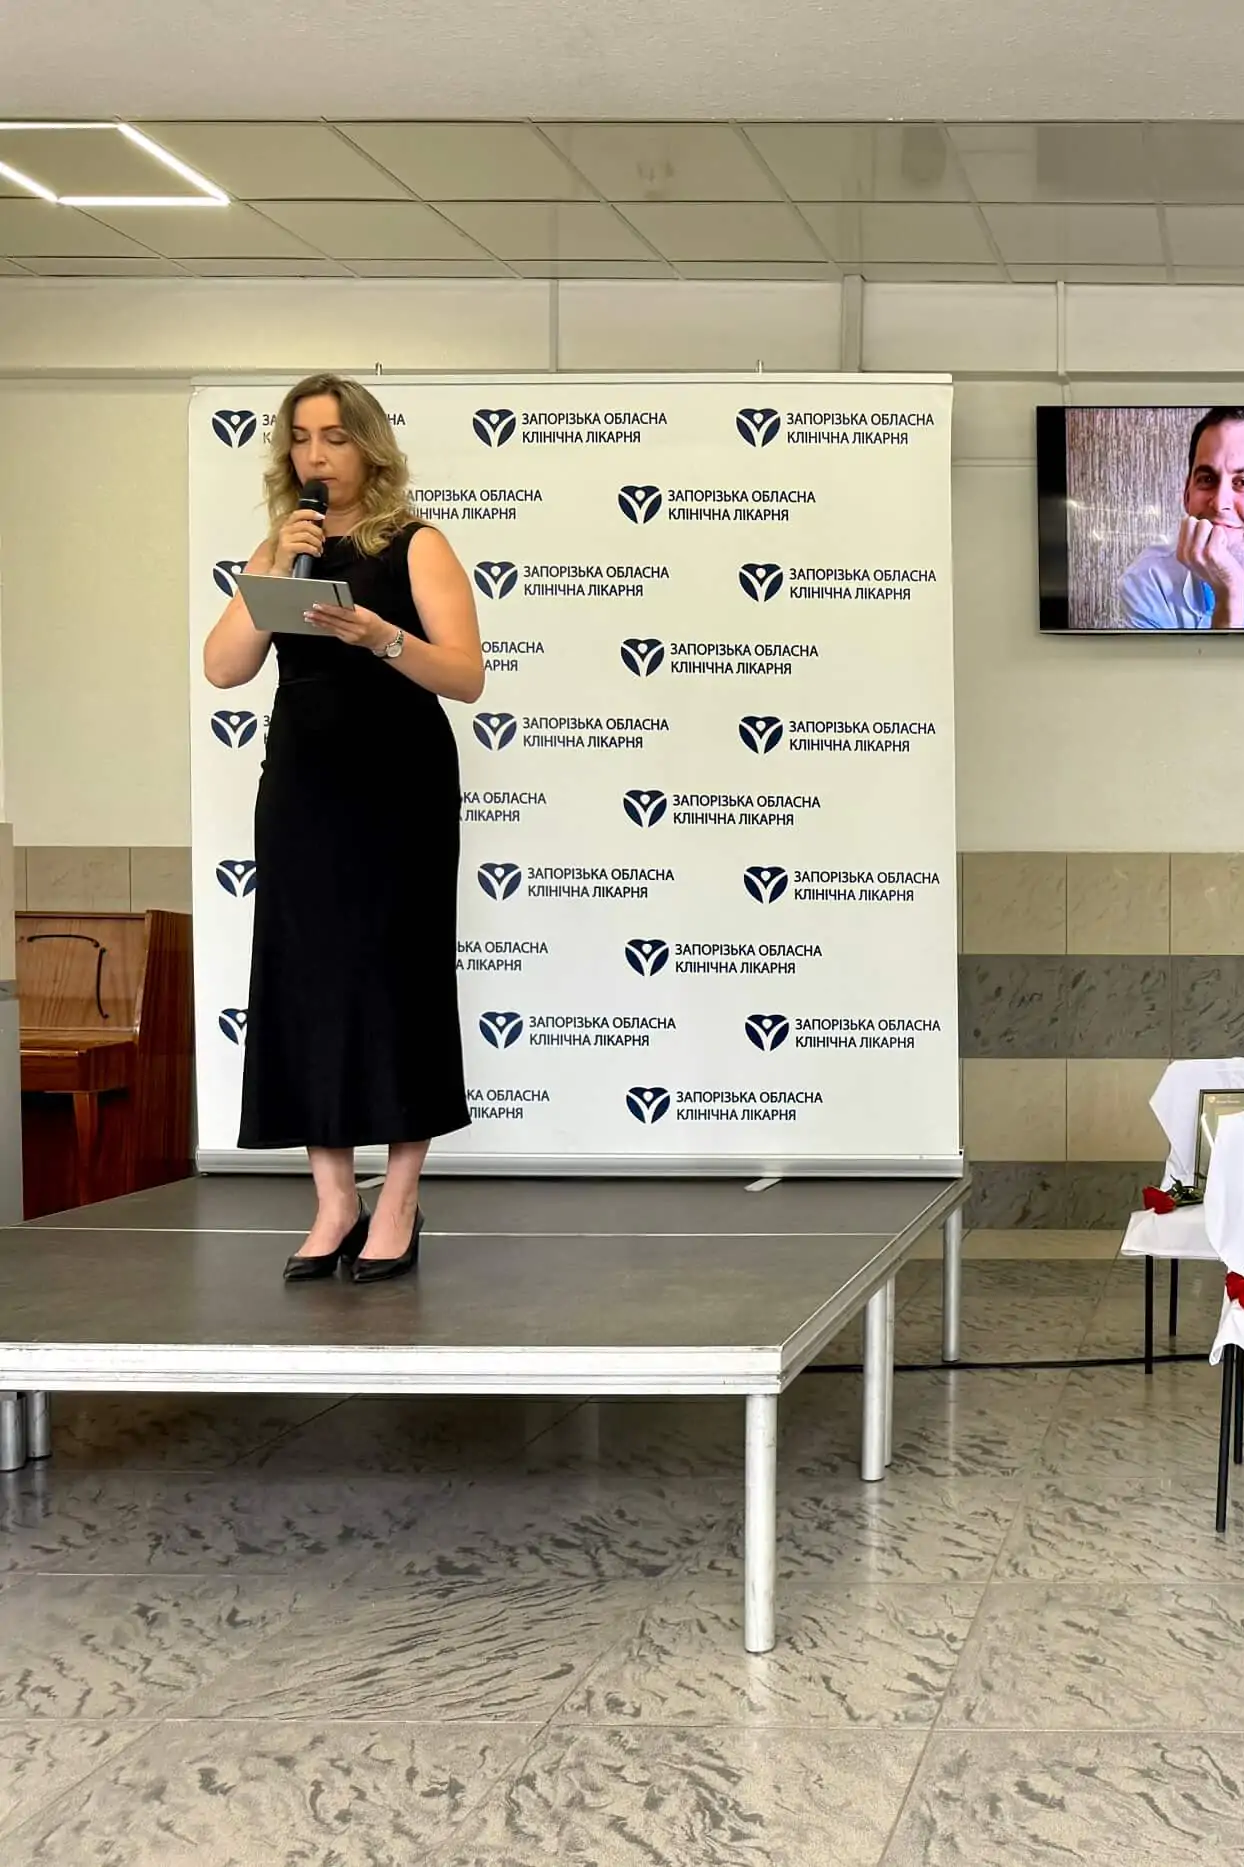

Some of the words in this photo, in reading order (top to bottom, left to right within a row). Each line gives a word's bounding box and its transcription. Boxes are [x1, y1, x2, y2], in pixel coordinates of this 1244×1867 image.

[522, 413, 601, 425] ЗАПОРІЗЬКА
[604, 413, 667, 424] ОБЛАСНА
[787, 413, 867, 425] ЗАПОРІЗЬКА
[871, 413, 934, 426] ОБЛАСНА
[523, 431, 583, 443] КЛІНІЧНА
[586, 431, 640, 443] ЛІКАРНЯ
[788, 432, 849, 444] КЛІНІЧНА
[853, 432, 908, 444] ЛІКАРНЯ
[406, 490, 477, 502] АПОРІЗЬКА
[480, 490, 542, 501] ОБЛАСНА
[668, 490, 748, 502] ЗАПОРІЗЬКА
[752, 490, 815, 503] ОБЛАСНА
[462, 508, 516, 519] ЛІКАРНЯ
[669, 508, 730, 520] КЛІНІЧНА
[734, 509, 788, 521] ЛІКАРНЯ
[524, 566, 603, 578] ЗАПОРІЗЬКА
[606, 566, 669, 578] ОБЛАСНА
[790, 568, 870, 581] ЗАПОРІЗЬКА
[873, 570, 936, 582] ОБЛАСНА
[524, 584, 585, 596] КЛІНІЧНА
[588, 584, 643, 596] ЛІКАРНЯ
[790, 587, 852, 599] КЛІНІЧНА
[855, 588, 910, 600] ЛІКАРНЯ
[481, 641, 545, 653] ОБЛАСНА
[671, 643, 751, 656] ЗАПОРІЗЬКА
[755, 644, 818, 656] ОБЛАСНА
[484, 659, 519, 671] АРНЯ
[671, 661, 733, 674] КЛІНІЧНА
[737, 662, 791, 674] ЛІКАРНЯ
[523, 717, 603, 729] ЗАПОРІЗЬКА
[606, 718, 669, 730] ОБЛАСНА
[789, 721, 870, 733] ЗАПОРІЗЬКА
[873, 722, 935, 734] ОБЛАСНА
[524, 735, 584, 747] КЛІНІЧНА
[587, 736, 642, 748] ЛІКАРНЯ
[790, 739, 851, 751] КЛІНІЧНА
[854, 740, 909, 752] ЛІКАРНЯ
[483, 791, 547, 804] ОБЛАСНА
[673, 795, 753, 807] ЗАПОРІЗЬКА
[757, 796, 820, 808] ОБЛАСНА
[464, 809, 520, 822] ЛІКАРНЯ
[674, 812, 736, 824] КЛІНІЧНА
[739, 813, 793, 825] ЛІКАРНЯ
[528, 867, 608, 880] ЗАПОРІЗЬКА
[611, 869, 674, 880] ОБЛАСНА
[794, 871, 874, 883] ЗАПОРІЗЬКА
[877, 872, 939, 884] ОБЛАСНА
[528, 885, 589, 897] КЛІНІЧНА
[592, 886, 647, 898] ЛІКАРНЯ
[795, 889, 856, 900] КЛІНІЧНА
[859, 889, 913, 901] ЛІКАРНЯ
[485, 941, 549, 953] ОБЛАСНА
[676, 944, 755, 956] ЗАПОРІЗЬКА
[759, 945, 822, 956] ОБЛАСНА
[467, 959, 522, 971] ЛІКАРНЯ
[676, 961, 737, 973] КЛІНІЧНА
[740, 962, 795, 974] ЛІКАРНЯ
[529, 1016, 609, 1028] ЗАПОРІЗЬКА
[613, 1017, 676, 1029] ОБЛАСНА
[796, 1019, 875, 1030] ЗАПОРІЗЬКА
[878, 1019, 940, 1031] ОБЛАСНА
[530, 1034, 591, 1045] КЛІНІЧНА
[594, 1035, 649, 1046] ЛІКАРНЯ
[796, 1036, 856, 1048] КЛІНІЧНА
[860, 1037, 914, 1048] ЛІКАРНЯ
[486, 1089, 550, 1101] ОБЛАСНА
[677, 1091, 756, 1103] ЗАПОРІЗЬКА
[760, 1092, 823, 1103] ОБЛАСНА
[469, 1106, 523, 1119] ЛІКАРНЯ
[677, 1109, 738, 1120] КЛІНІЧНА
[741, 1109, 796, 1120] ЛІКАРНЯ
